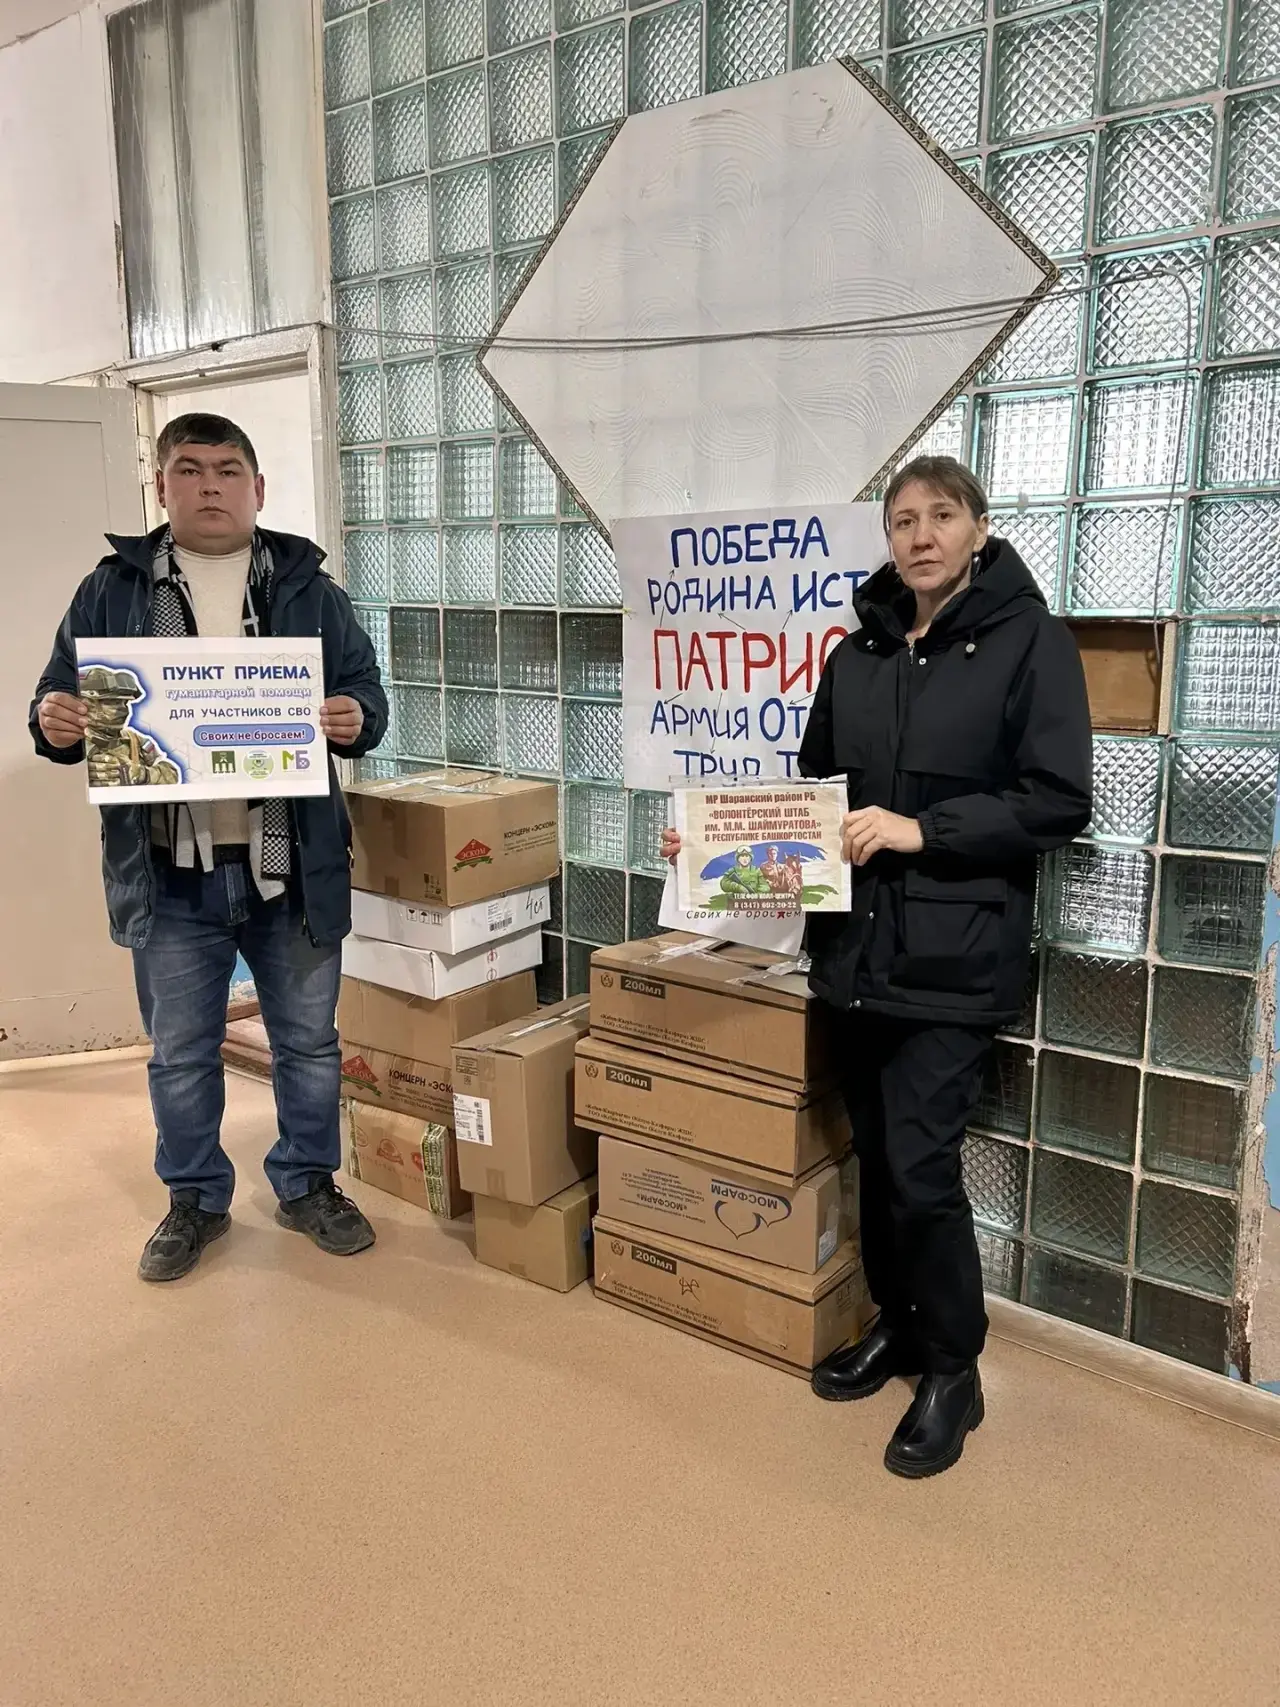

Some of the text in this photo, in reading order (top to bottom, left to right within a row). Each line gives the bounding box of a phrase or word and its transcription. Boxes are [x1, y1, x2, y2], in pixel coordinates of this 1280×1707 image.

[671, 516, 829, 568] ПОБЕДА
[647, 575, 776, 615] РОДИНА
[162, 666, 311, 680] ПУНКТ ПРИЕМА
[165, 687, 311, 700] гуманитарной помощи
[169, 707, 311, 720] ДЛЯ УЧАСТНИКОВ СВО
[650, 700, 749, 740] АРМИЯ
[200, 730, 305, 742] Своих не бросаем!
[705, 791, 816, 804] МР Шаранский район РБ
[784, 807, 809, 817] ШТАБ
[724, 822, 745, 831] М.М.
[748, 819, 821, 831] ШАЙМУРАТОВА»
[504, 827, 531, 839] КОНЦЕРН
[705, 831, 822, 842] В РЕСПУБЛИКЕ БАШКОРТОСТАН
[461, 848, 486, 859] ЭСКОМ
[686, 910, 721, 919] Своих
[726, 910, 740, 918] не
[624, 979, 662, 996] 200мл
[389, 1069, 426, 1087] КОНЦЕРН
[610, 1070, 648, 1088] 200мл
[711, 1184, 778, 1210] МОСФАРМ
[635, 1249, 674, 1272] 200мл
